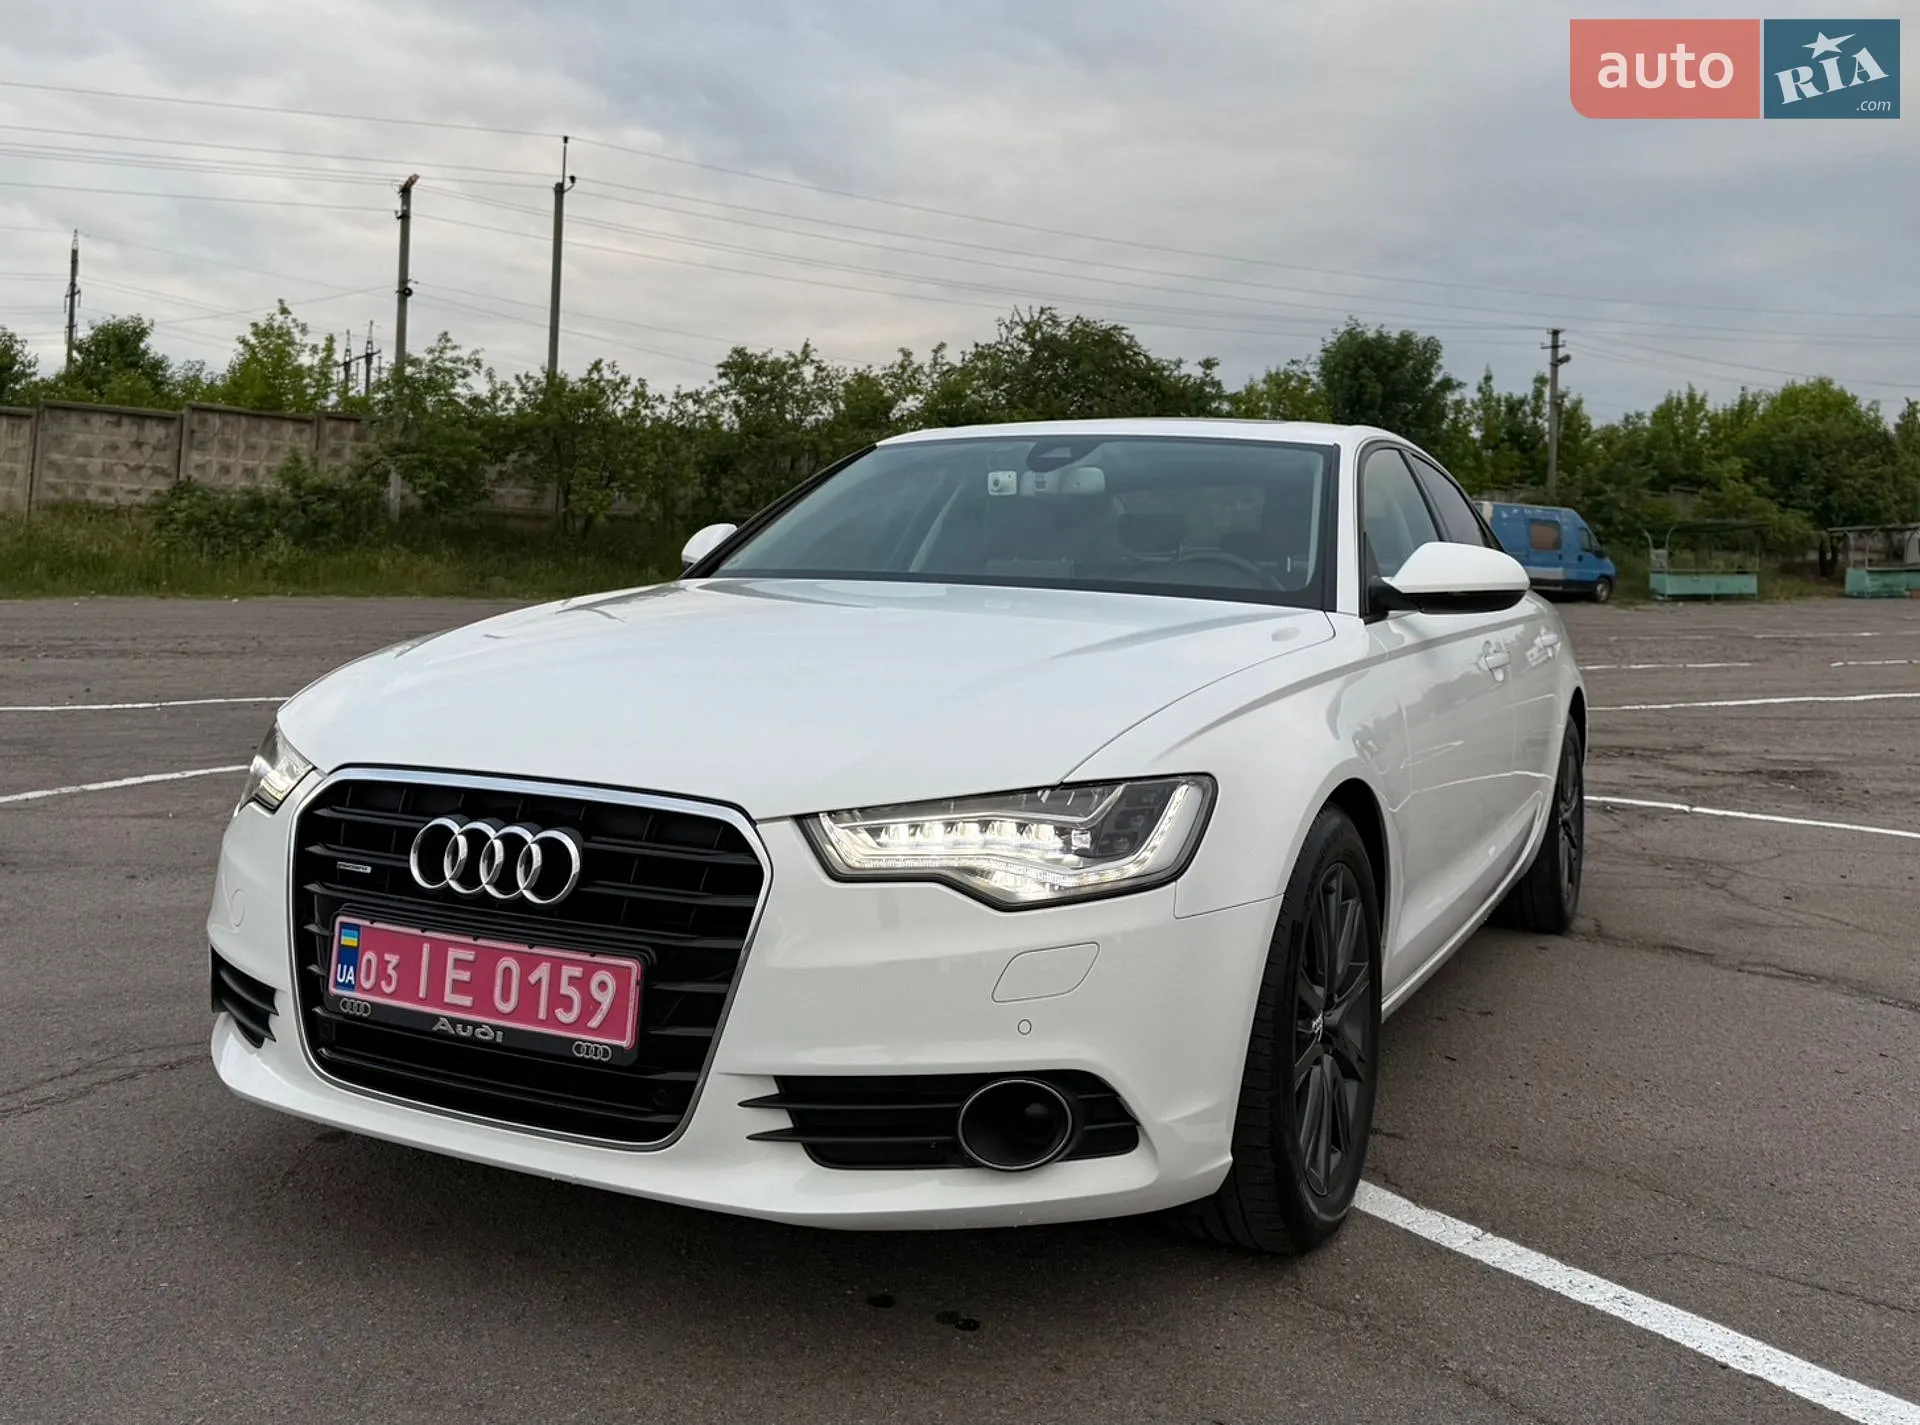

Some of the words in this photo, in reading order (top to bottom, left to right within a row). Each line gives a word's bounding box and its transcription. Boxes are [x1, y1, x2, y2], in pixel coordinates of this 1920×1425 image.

[336, 963, 355, 985] UA
[360, 950, 400, 994] 03
[418, 943, 475, 1007] IE
[493, 956, 617, 1029] 0159
[431, 1016, 503, 1043] Audi
